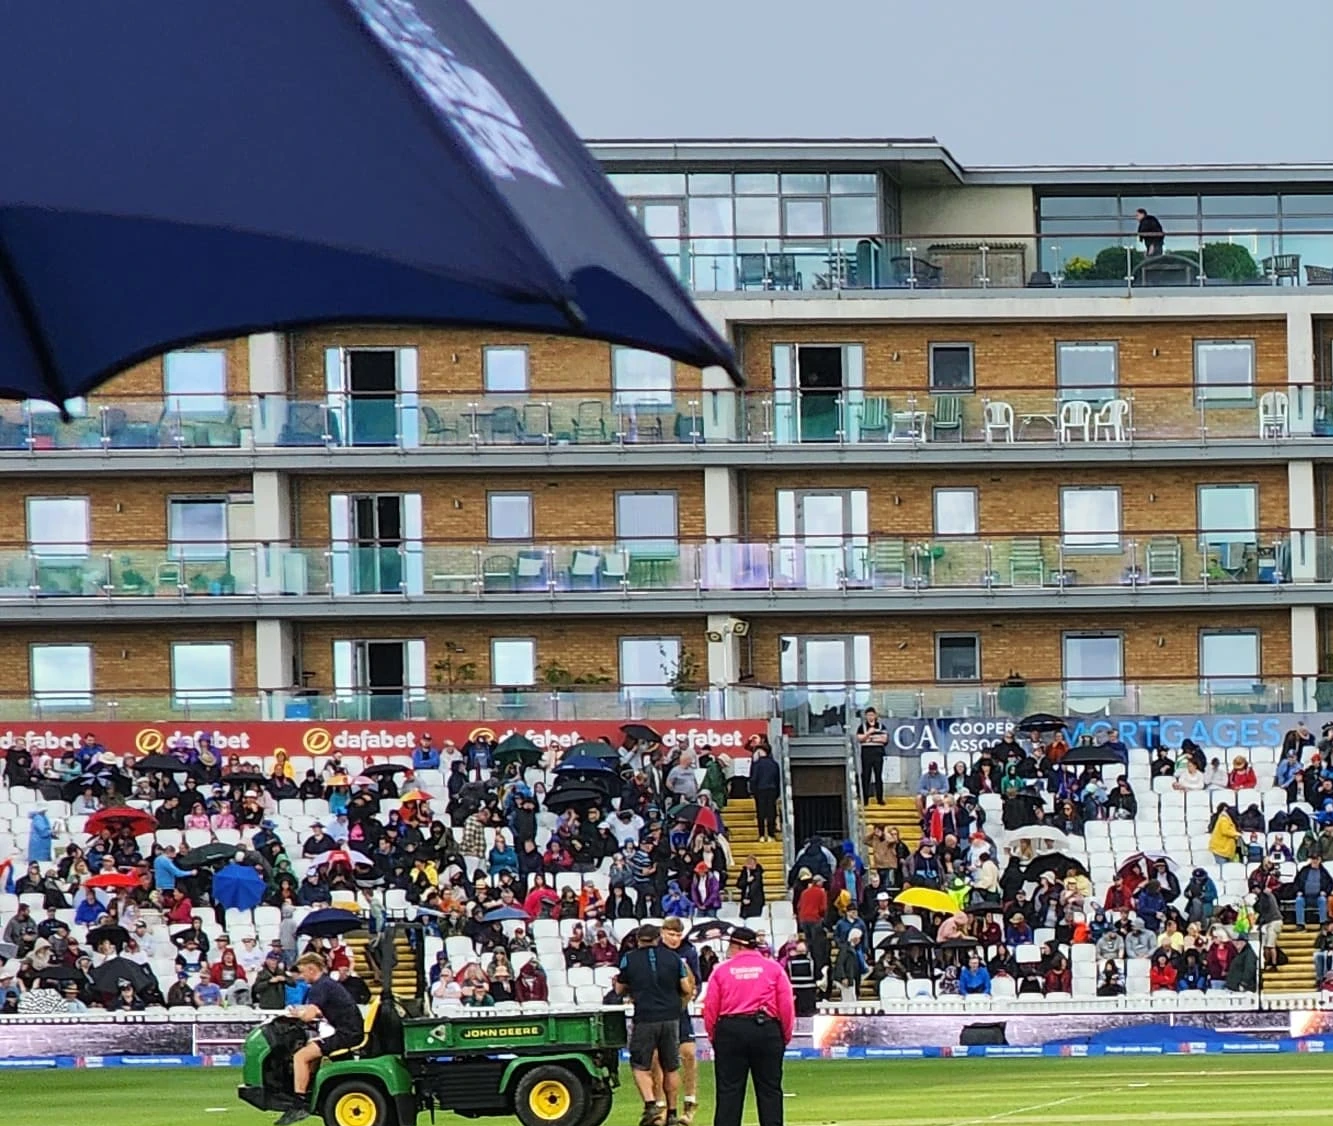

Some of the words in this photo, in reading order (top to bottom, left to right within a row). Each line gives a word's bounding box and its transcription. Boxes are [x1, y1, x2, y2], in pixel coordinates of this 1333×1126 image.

[893, 725, 939, 750] CA
[949, 722, 1014, 736] COOPER
[333, 729, 416, 751] dafabet
[464, 1029, 498, 1038] JOHN
[499, 1026, 539, 1036] DEERE
